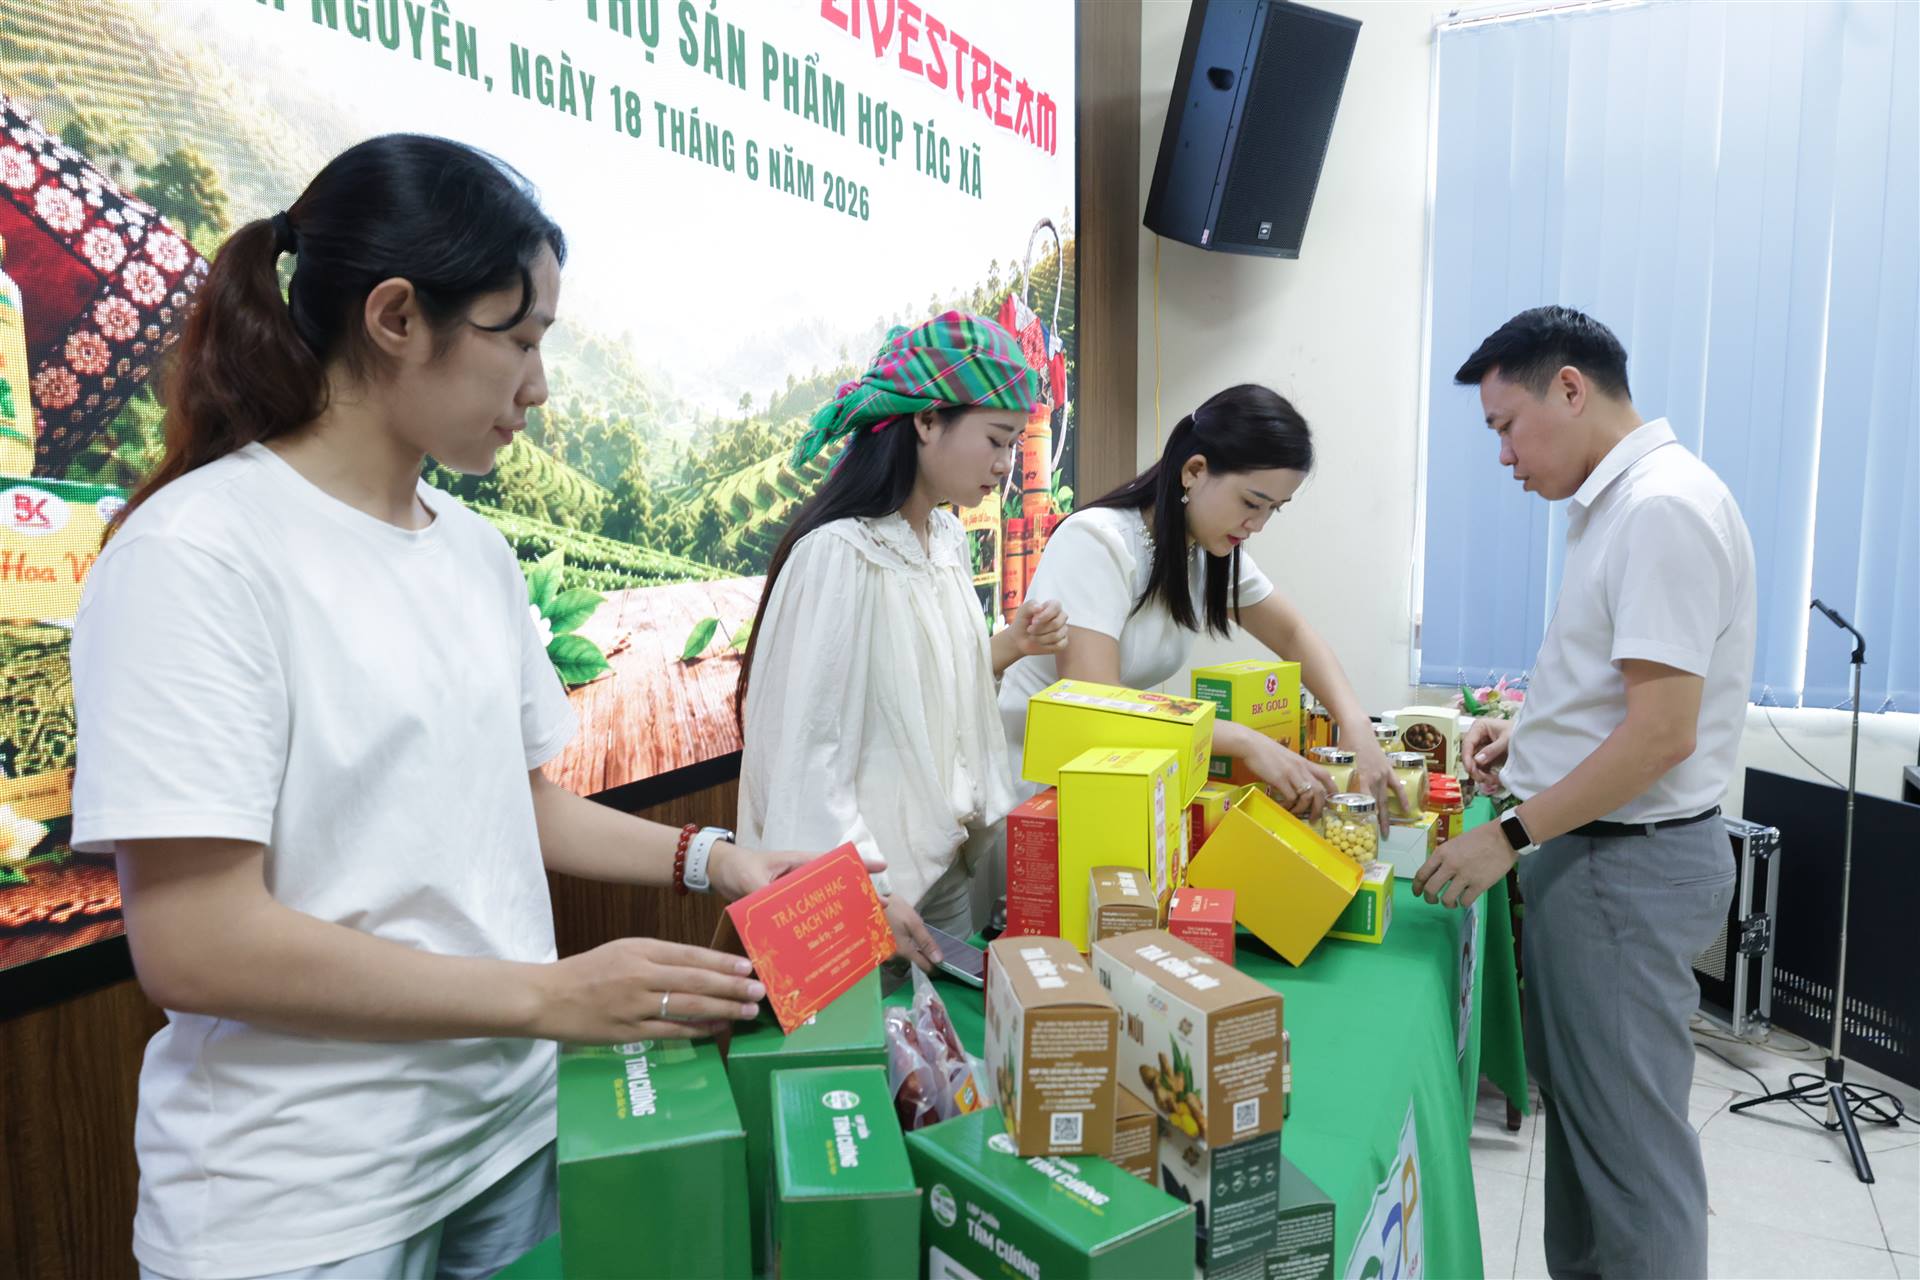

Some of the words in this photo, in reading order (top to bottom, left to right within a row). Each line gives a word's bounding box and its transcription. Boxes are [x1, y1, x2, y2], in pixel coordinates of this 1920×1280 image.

[678, 0, 747, 91] SẢN
[762, 41, 846, 137] PHẨM
[858, 92, 904, 166] HỢP
[913, 118, 951, 184] TÁC
[959, 142, 983, 200] XÃ
[510, 42, 596, 122] NGÀY
[610, 85, 642, 139] 18
[654, 101, 736, 174] THÁNG
[745, 139, 759, 181] 6
[768, 144, 815, 203] NĂM
[823, 170, 870, 222] 2026
[0, 550, 57, 583] Hoa
[1251, 702, 1264, 716] BK
[1265, 697, 1289, 712] GOLD
[771, 903, 798, 928] TRÀ
